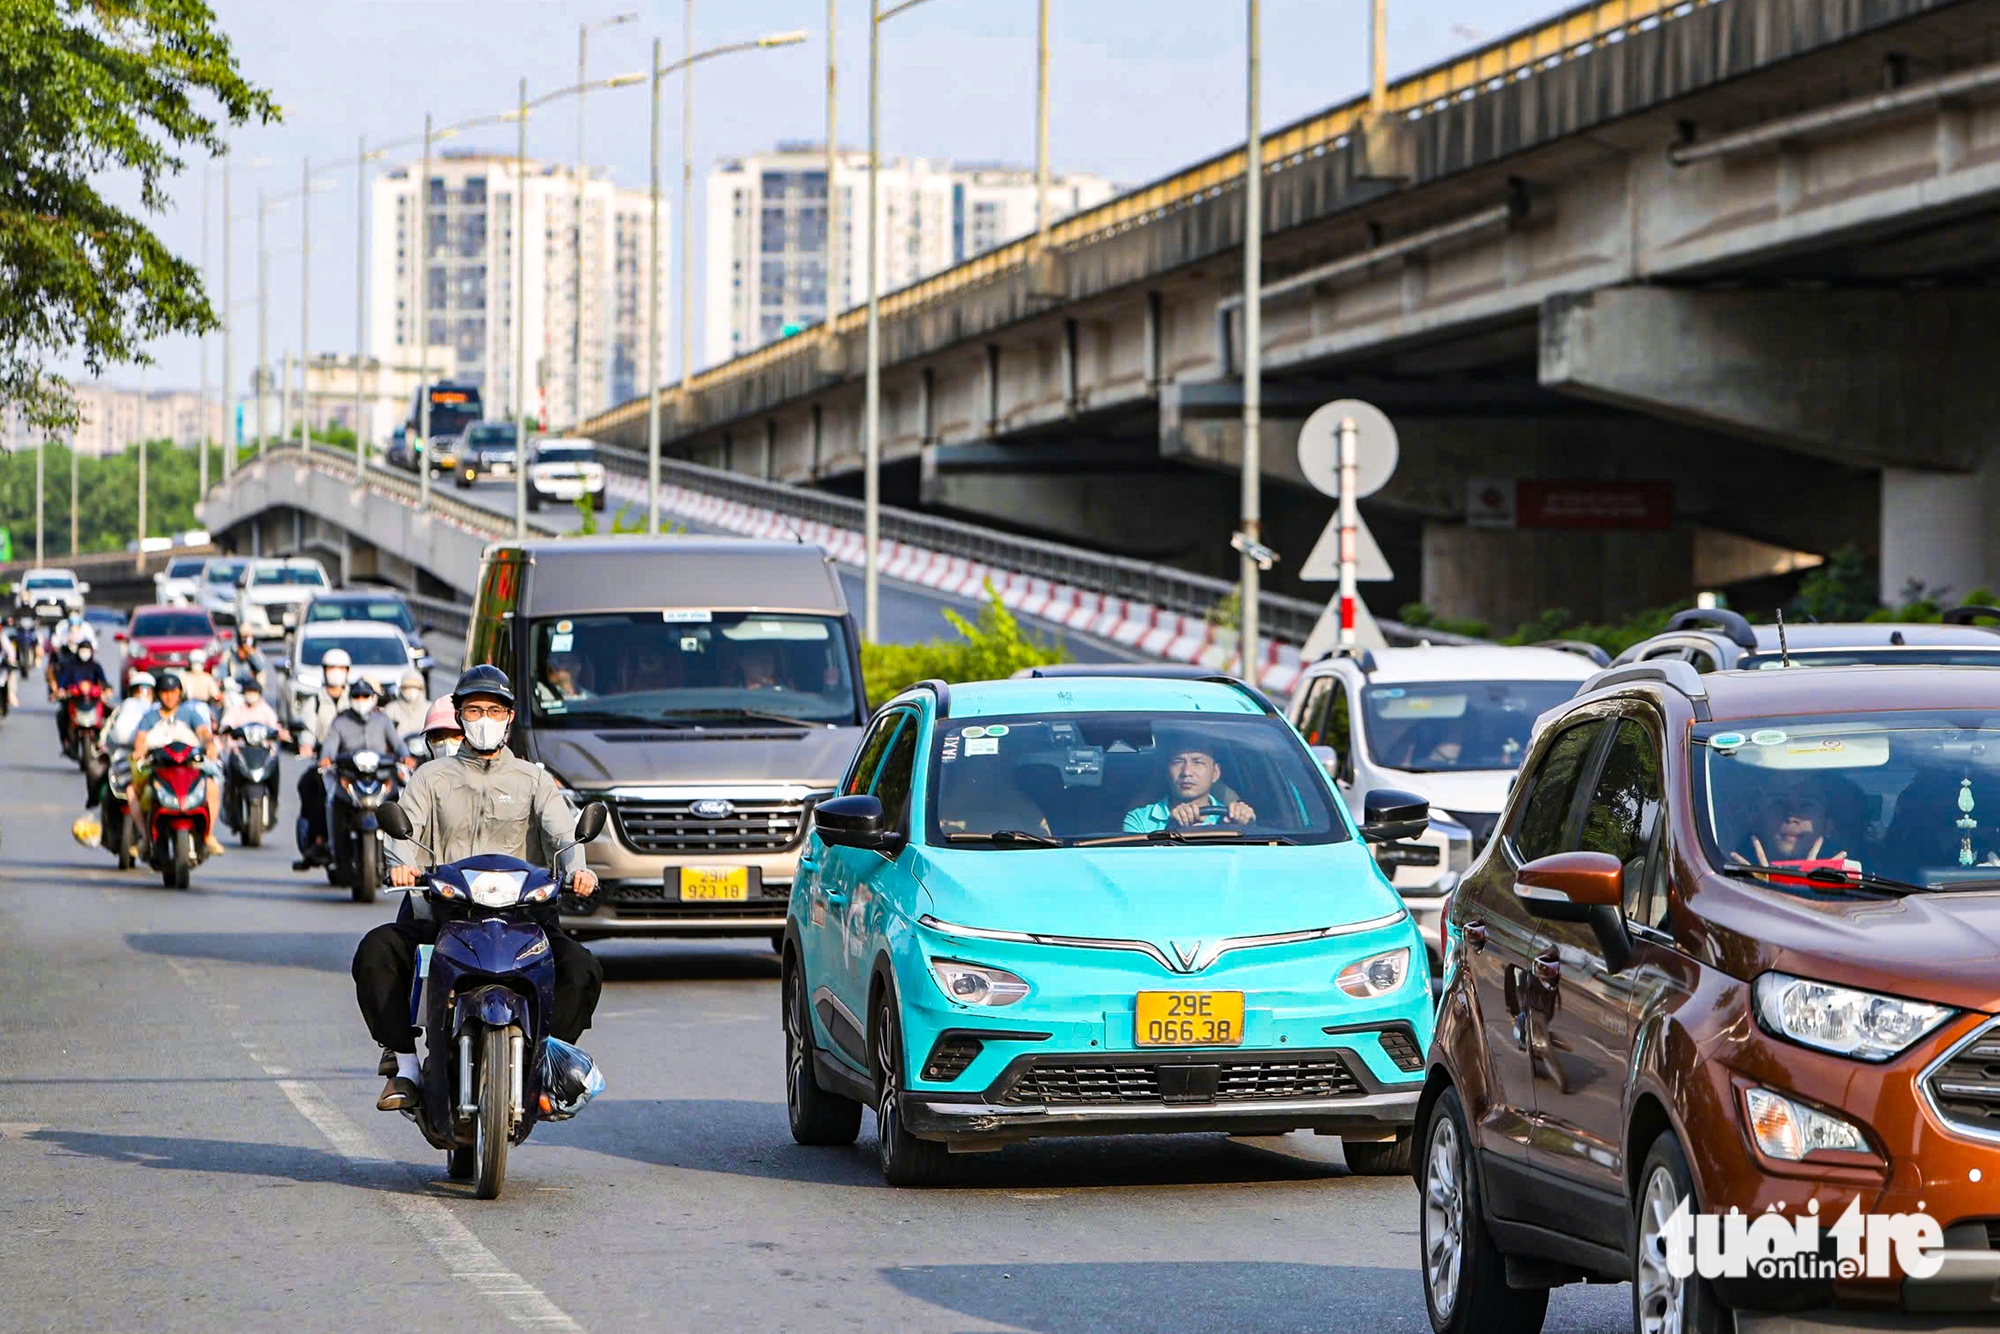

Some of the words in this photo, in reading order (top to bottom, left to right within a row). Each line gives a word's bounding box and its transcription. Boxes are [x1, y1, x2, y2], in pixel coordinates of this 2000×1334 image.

[688, 884, 739, 898] 923.18
[1168, 995, 1212, 1016] 29E
[1149, 1020, 1231, 1041] 066.38
